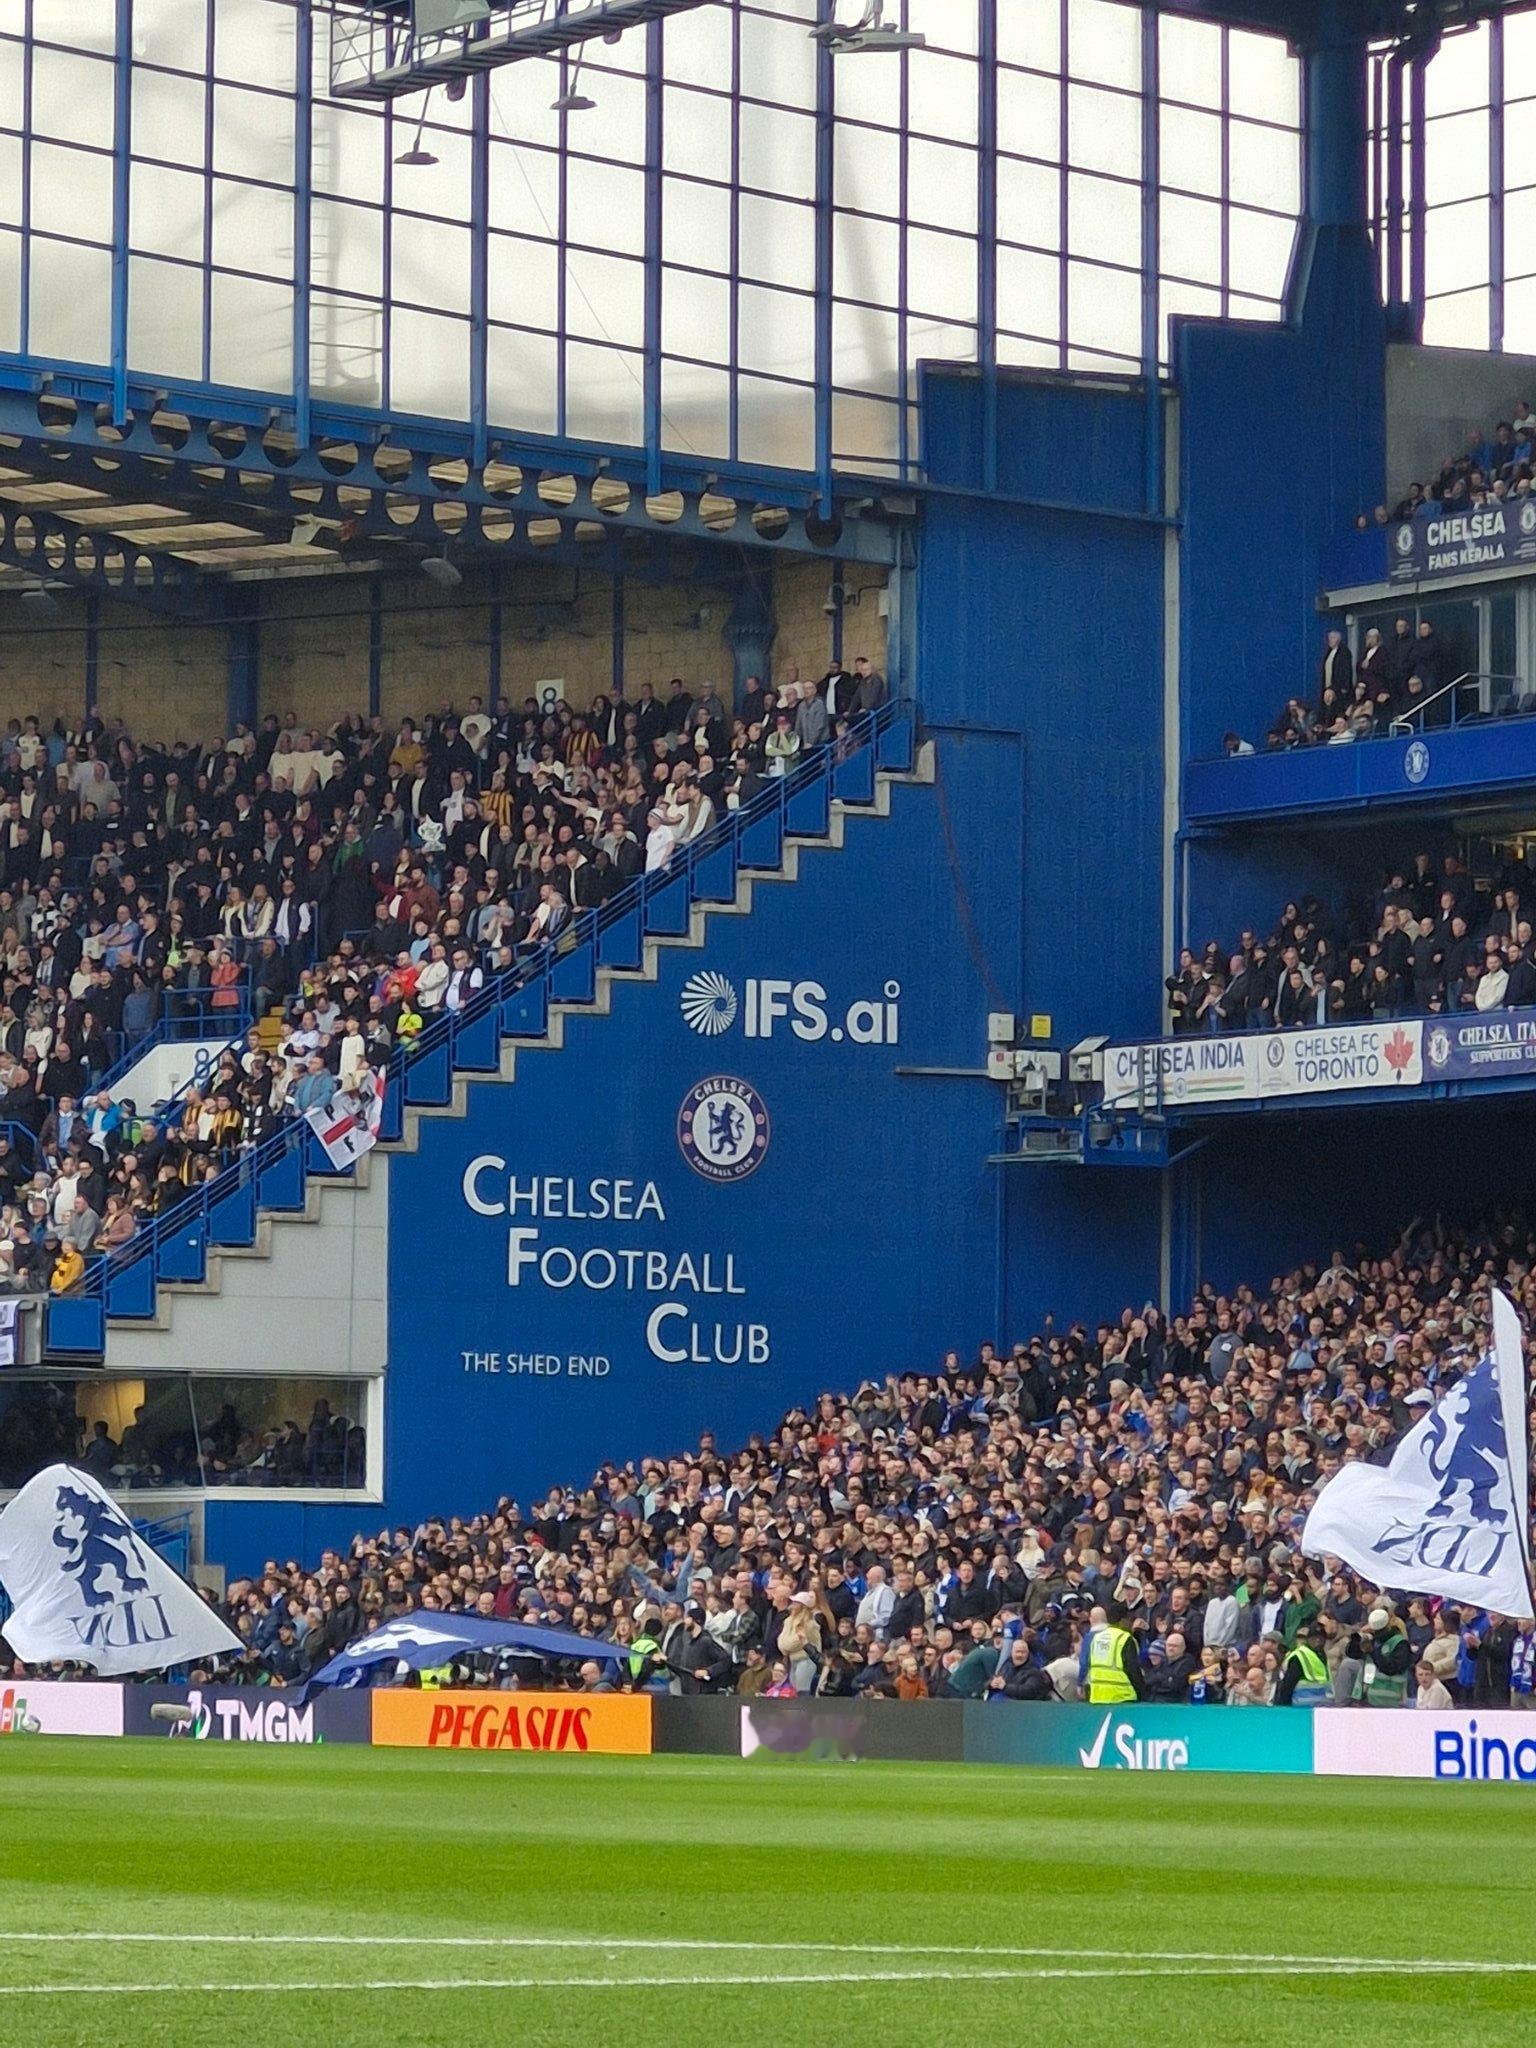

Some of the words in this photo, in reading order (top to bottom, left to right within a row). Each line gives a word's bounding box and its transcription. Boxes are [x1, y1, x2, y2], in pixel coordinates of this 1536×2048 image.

[1426, 511, 1506, 547] CHELSEA
[1428, 551, 1458, 571] FANS
[542, 687, 557, 716] 8
[745, 979, 899, 1044] IFS.ai
[1295, 1035, 1357, 1058] CHELSEA
[1361, 1033, 1379, 1052] FC
[1458, 1024, 1512, 1046] CHELSEA
[1117, 1045, 1196, 1078] CHELSEA
[1200, 1042, 1245, 1070] INDIA
[1295, 1054, 1379, 1084] TORONTO
[694, 1079, 754, 1105] CHELSEA
[463, 1154, 666, 1222] CHELSEA
[508, 1227, 746, 1294] FOOTBALL
[646, 1302, 770, 1364] CLUB
[461, 1352, 501, 1374] THE
[507, 1353, 561, 1376] SHED
[567, 1356, 611, 1377] END
[216, 1699, 314, 1743] TMGM
[428, 1704, 591, 1752] PEGASUS
[1115, 1723, 1189, 1770] Sure
